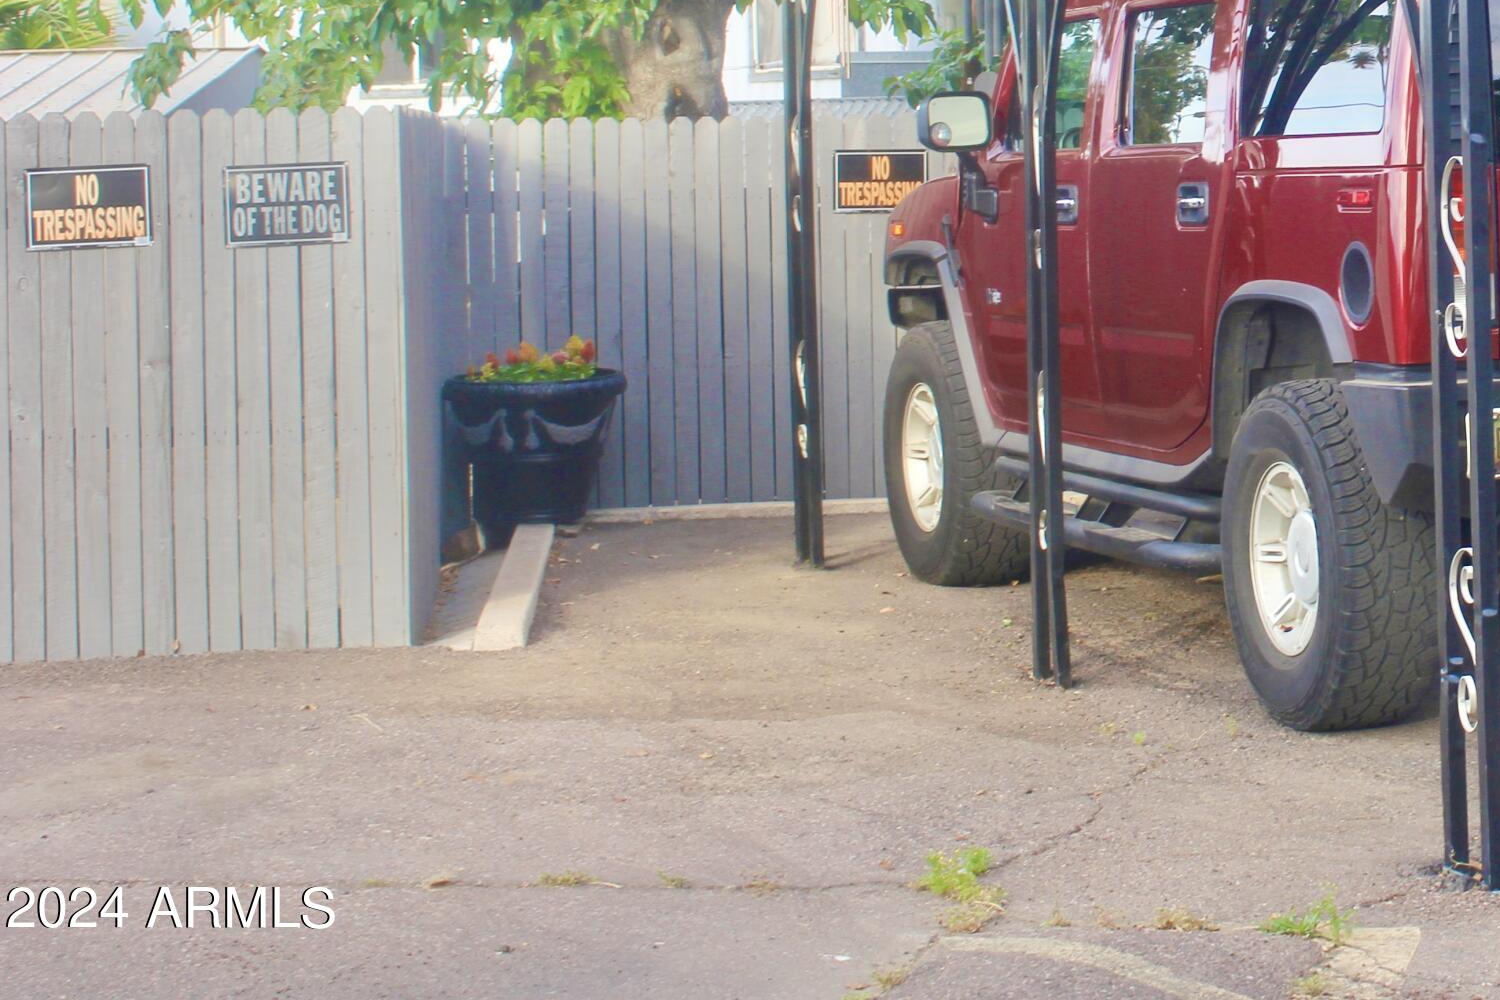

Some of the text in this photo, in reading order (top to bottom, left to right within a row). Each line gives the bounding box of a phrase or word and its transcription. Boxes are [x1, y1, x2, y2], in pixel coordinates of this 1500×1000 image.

[872, 155, 891, 180] NO
[74, 173, 99, 206] NO
[235, 170, 337, 204] BEWARE
[839, 181, 922, 207] TRESPASSI
[33, 205, 146, 242] TRESPASSING
[233, 203, 341, 237] OF THE DOG
